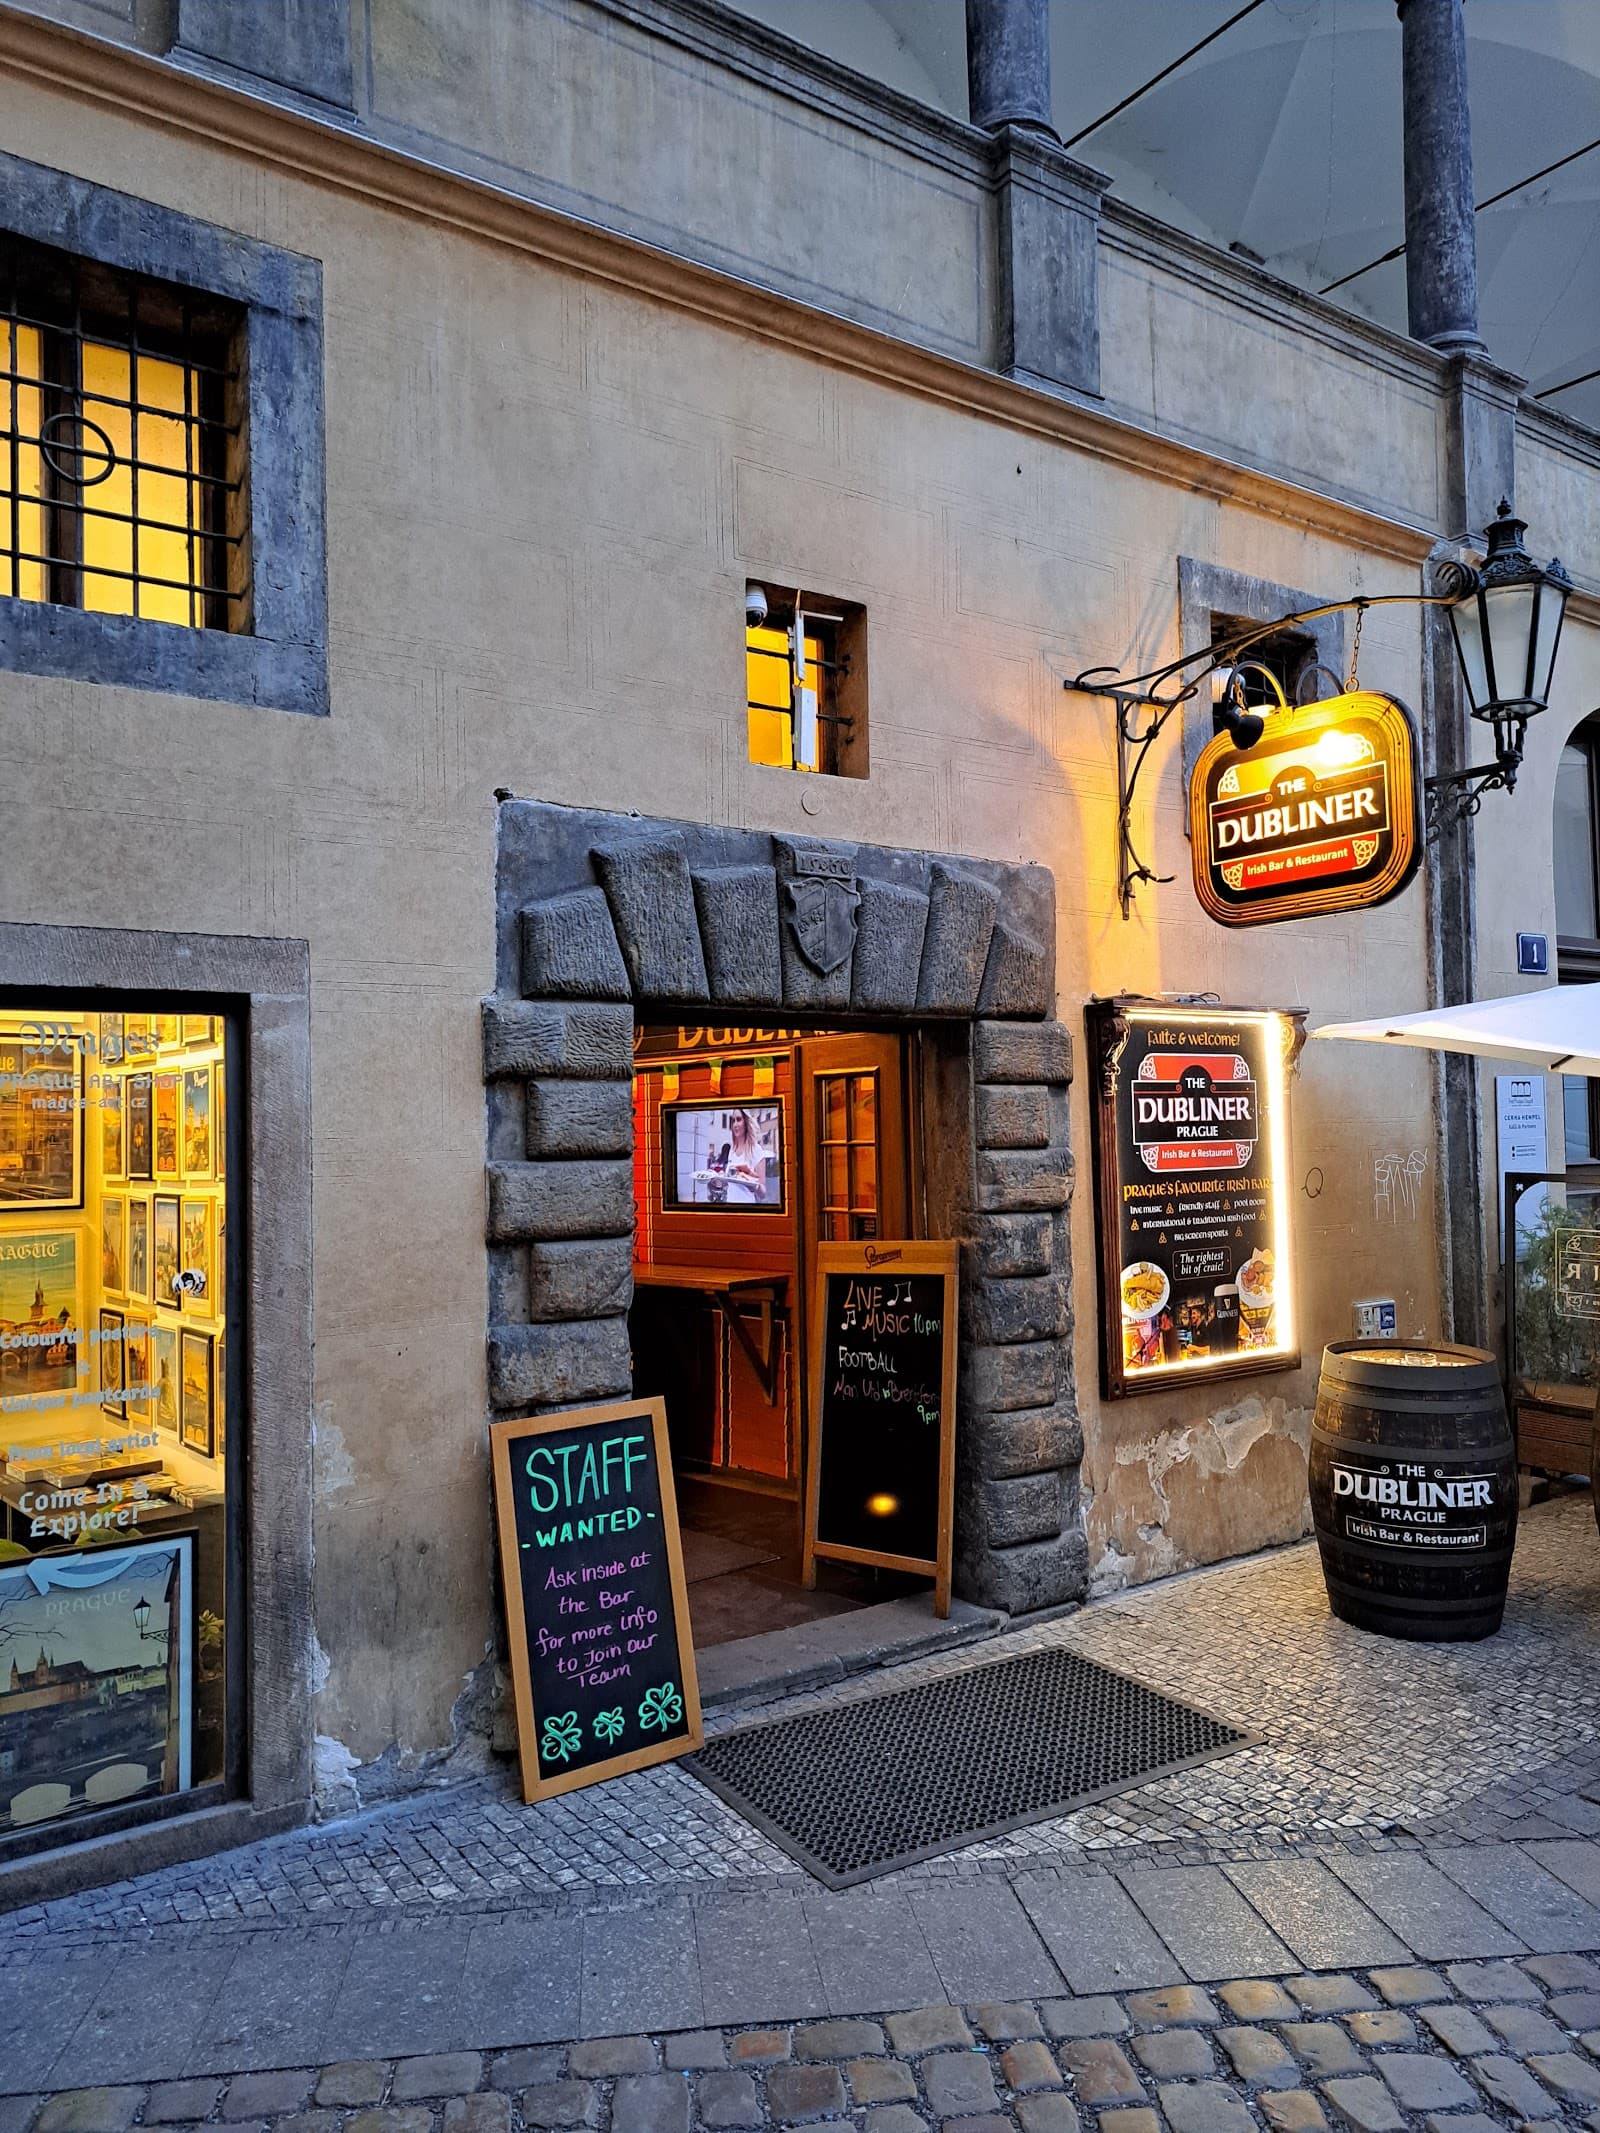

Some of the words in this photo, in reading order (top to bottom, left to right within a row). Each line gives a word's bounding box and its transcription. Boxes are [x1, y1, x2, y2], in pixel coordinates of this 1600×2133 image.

[1277, 777, 1307, 796] THE
[1217, 787, 1379, 849] DUBLINER
[1247, 860, 1267, 876] Irish
[1268, 857, 1285, 872] Bar
[1286, 855, 1294, 868] &
[1295, 848, 1348, 866] Restaurant
[1532, 942, 1538, 964] 1
[20, 1021, 160, 1064] Mages
[1178, 1032, 1186, 1045] &
[1188, 1031, 1240, 1047] welcome!
[0, 1074, 80, 1090] PRAGUE
[88, 1073, 127, 1089] ART
[133, 1073, 184, 1088] SHOP
[1185, 1077, 1206, 1089] THE
[32, 1096, 148, 1112] mages-art.cz
[1138, 1097, 1252, 1123] DUBLINER
[1177, 1125, 1219, 1138] PRAGUE
[1162, 1149, 1177, 1159] Irish
[1178, 1149, 1190, 1159] Bar
[1191, 1149, 1197, 1158] &
[1197, 1147, 1233, 1157] Restaurant
[0, 1242, 59, 1260] AGUE
[1180, 1252, 1195, 1264] The
[1196, 1250, 1224, 1265] rightest
[1181, 1264, 1192, 1275] bit
[1193, 1262, 1202, 1277] of
[1203, 1260, 1224, 1273] craic!
[843, 1280, 882, 1312] LIVE
[0, 1328, 85, 1349] Colourful
[90, 1324, 157, 1346] posters
[862, 1308, 910, 1342] MUSIC
[913, 1312, 942, 1336] 10pm
[839, 1345, 897, 1373] FOOTBALL
[72, 1382, 161, 1411] postcards
[917, 1404, 941, 1425] 9pm
[108, 1431, 159, 1452] artist
[525, 1435, 648, 1512] STAFF
[1395, 1463, 1426, 1477] THE
[18, 1490, 85, 1513] Come
[96, 1481, 123, 1504] In
[133, 1479, 149, 1500] &
[1333, 1468, 1494, 1508] DUBLINER
[30, 1506, 139, 1541] Explore!
[1380, 1507, 1447, 1523] PRAGUE
[1352, 1522, 1377, 1538] Irish
[1379, 1529, 1401, 1542] Bar
[1402, 1531, 1413, 1543] &
[1415, 1532, 1480, 1545] Restaurant
[544, 1566, 577, 1590] Ask
[581, 1560, 627, 1583] inside
[630, 1551, 652, 1568] at
[45, 1588, 131, 1617] PRAGUE
[558, 1596, 590, 1614] the
[600, 1590, 635, 1609] Bar
[536, 1627, 566, 1657] for
[572, 1624, 613, 1645] more
[621, 1606, 658, 1630] info
[557, 1657, 578, 1674] to
[584, 1645, 621, 1667] Join
[627, 1634, 658, 1653] our
[567, 1664, 632, 1688] Team
